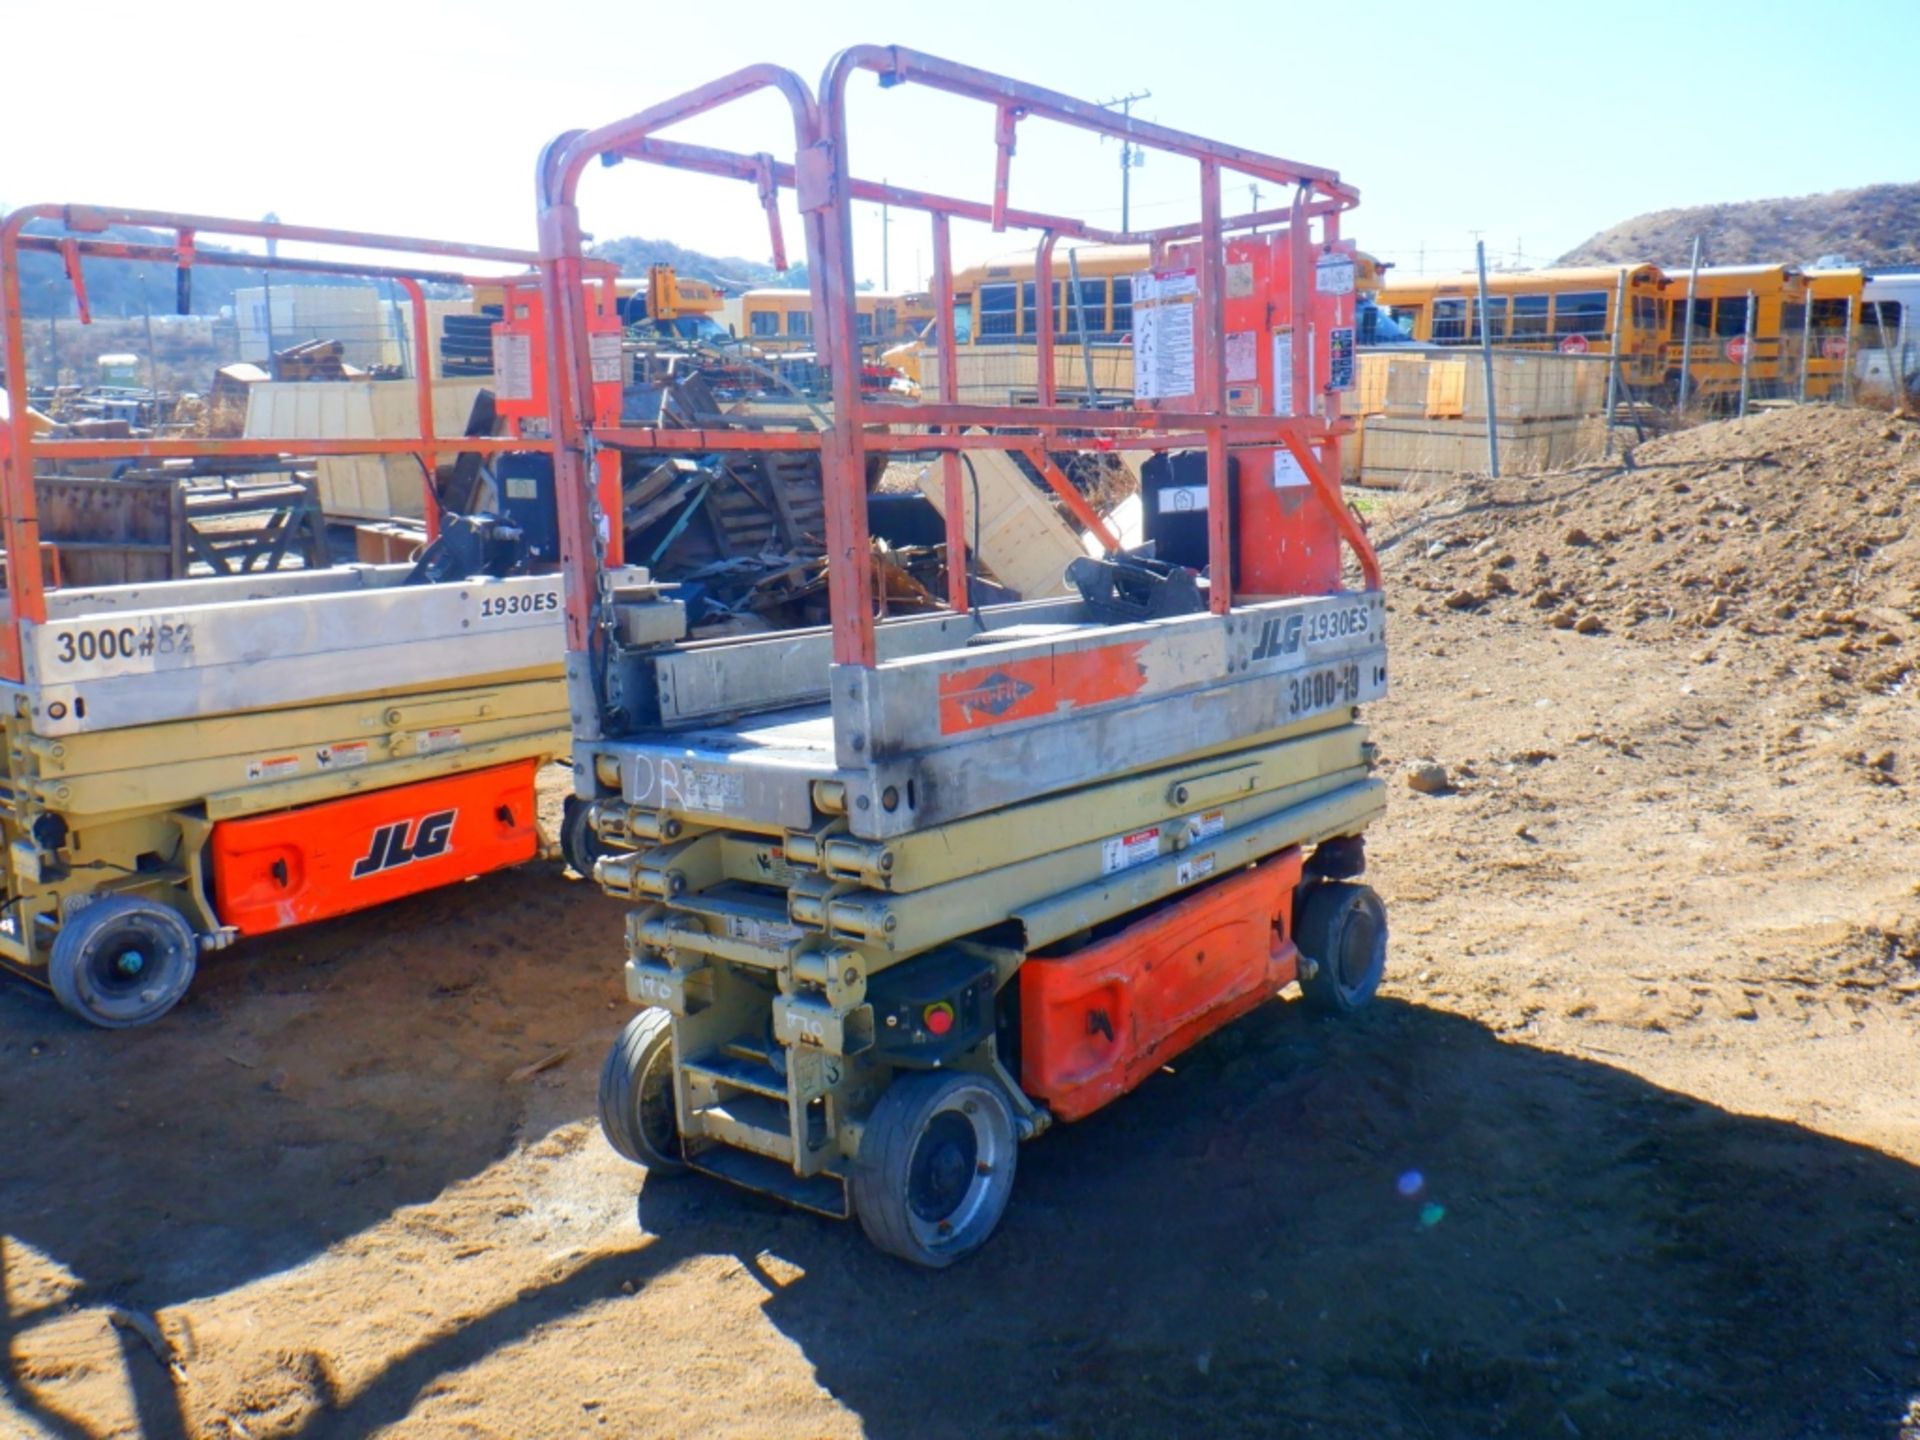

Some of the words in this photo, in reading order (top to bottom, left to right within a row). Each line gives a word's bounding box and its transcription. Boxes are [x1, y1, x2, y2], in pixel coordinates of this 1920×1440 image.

[481, 592, 558, 617] 1930ES
[1252, 614, 1304, 661] JLG
[1307, 607, 1369, 642] 1930ES
[351, 808, 459, 880] JLG
